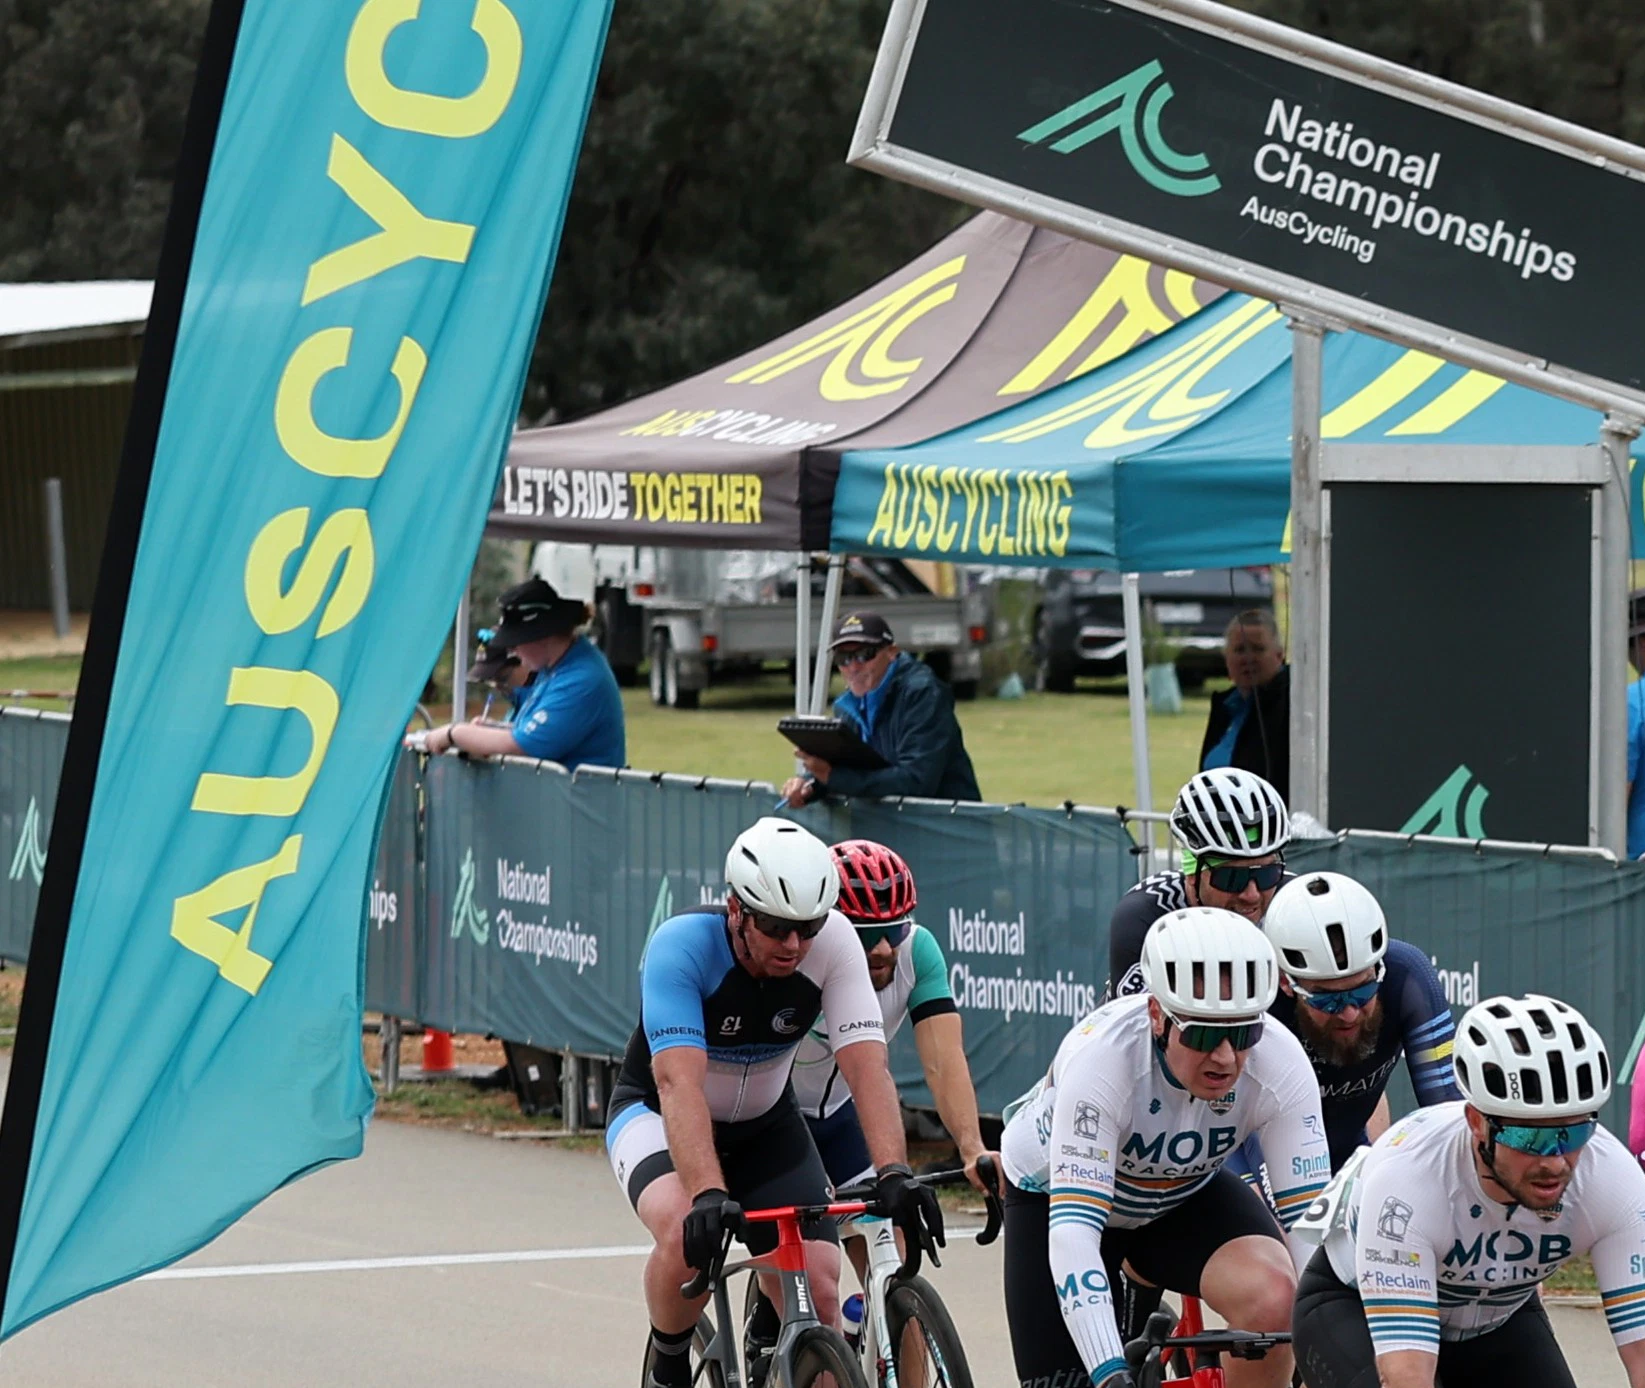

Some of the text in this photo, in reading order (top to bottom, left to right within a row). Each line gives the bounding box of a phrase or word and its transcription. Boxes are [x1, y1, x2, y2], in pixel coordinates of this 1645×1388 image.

[1264, 99, 1441, 189] National
[1240, 197, 1376, 263] AusCycling
[1253, 142, 1577, 282] Championships
[618, 408, 837, 446] AUSCYCLING
[503, 465, 763, 524] LET'S RIDE TOGETHER
[867, 462, 1074, 557] AUSCYCLING
[496, 858, 550, 905] National
[496, 908, 598, 975] Championships
[949, 906, 1025, 955] National
[951, 962, 1096, 1026] Championships
[1121, 1126, 1236, 1166] MOB
[1121, 1157, 1224, 1177] RACING
[1442, 1229, 1572, 1267] MOB
[794, 1275, 809, 1313] BMC
[1375, 1271, 1431, 1291] Reclaim
